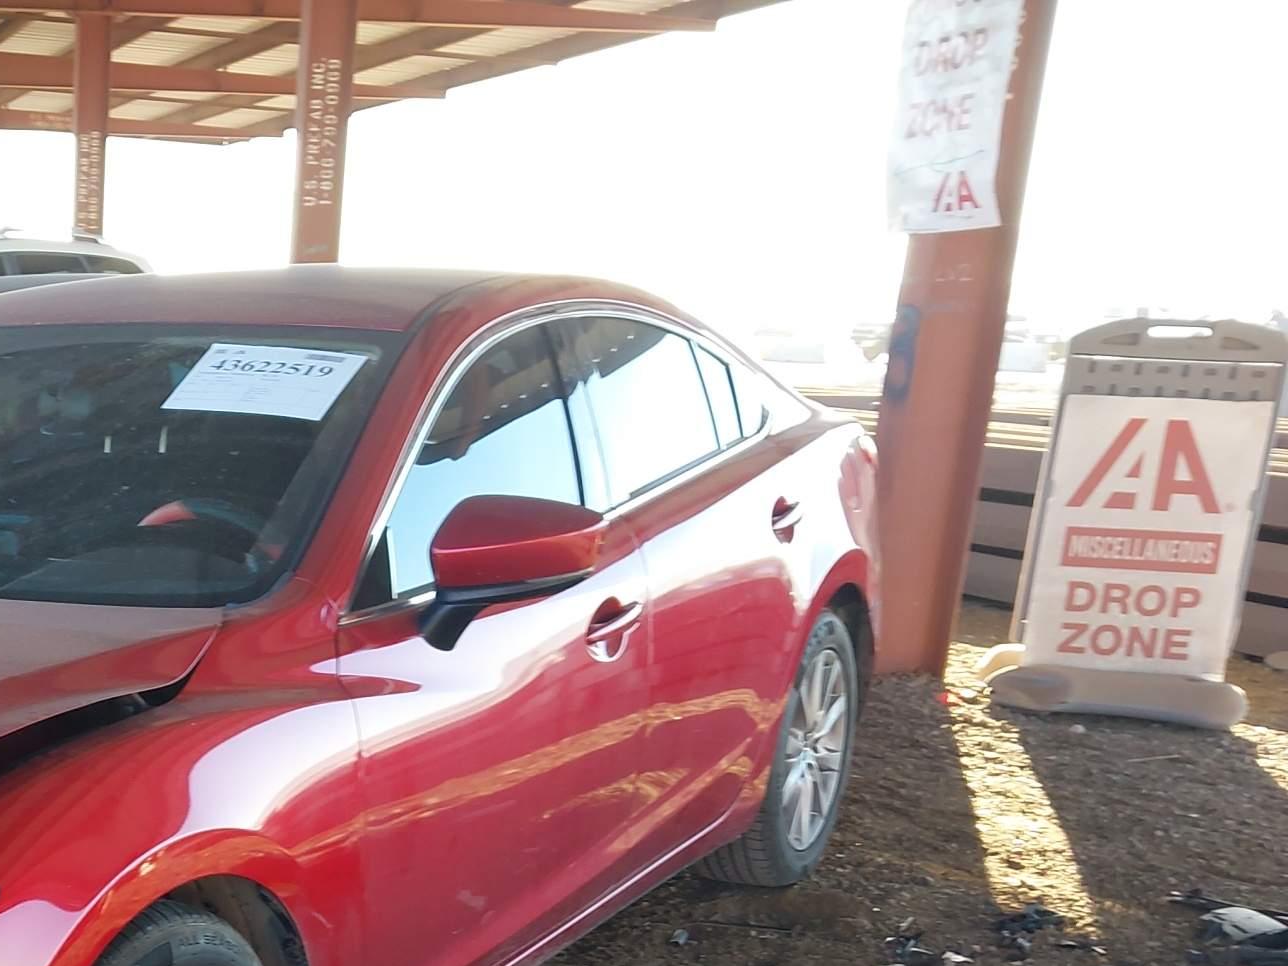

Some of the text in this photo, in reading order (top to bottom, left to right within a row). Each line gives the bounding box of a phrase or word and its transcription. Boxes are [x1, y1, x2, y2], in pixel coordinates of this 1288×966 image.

[904, 93, 975, 139] ZONE
[209, 359, 334, 377] 43622519
[1067, 534, 1216, 565] MISCELLANEOUS
[1063, 580, 1203, 618] DROP
[1056, 622, 1193, 661] ZONE
